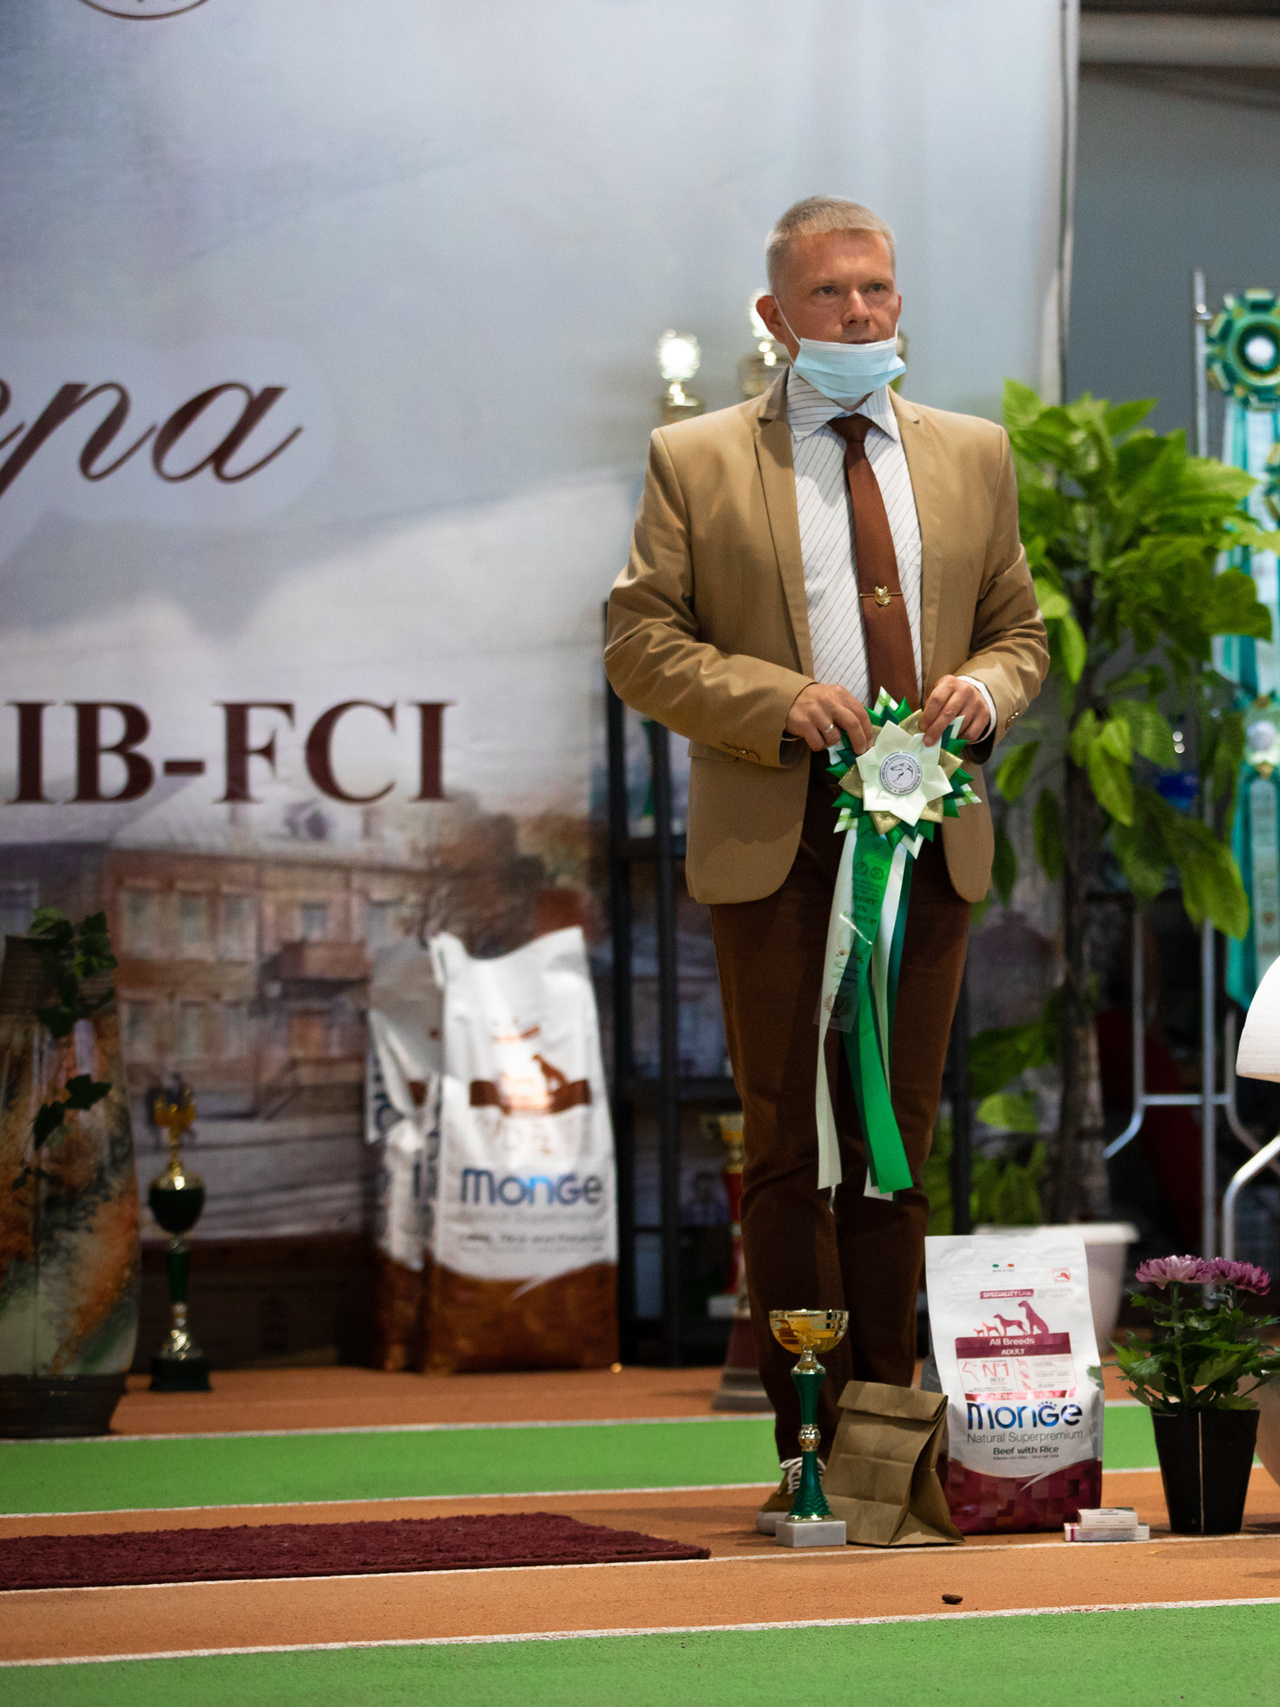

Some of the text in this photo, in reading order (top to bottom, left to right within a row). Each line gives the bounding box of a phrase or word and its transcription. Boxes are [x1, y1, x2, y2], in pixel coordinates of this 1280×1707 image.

[989, 1336, 1035, 1346] All Breeds
[1001, 1347, 1025, 1356] ADULT
[967, 1430, 1083, 1444] Natural Superpremium
[993, 1445, 1059, 1455] Beef with Rice
